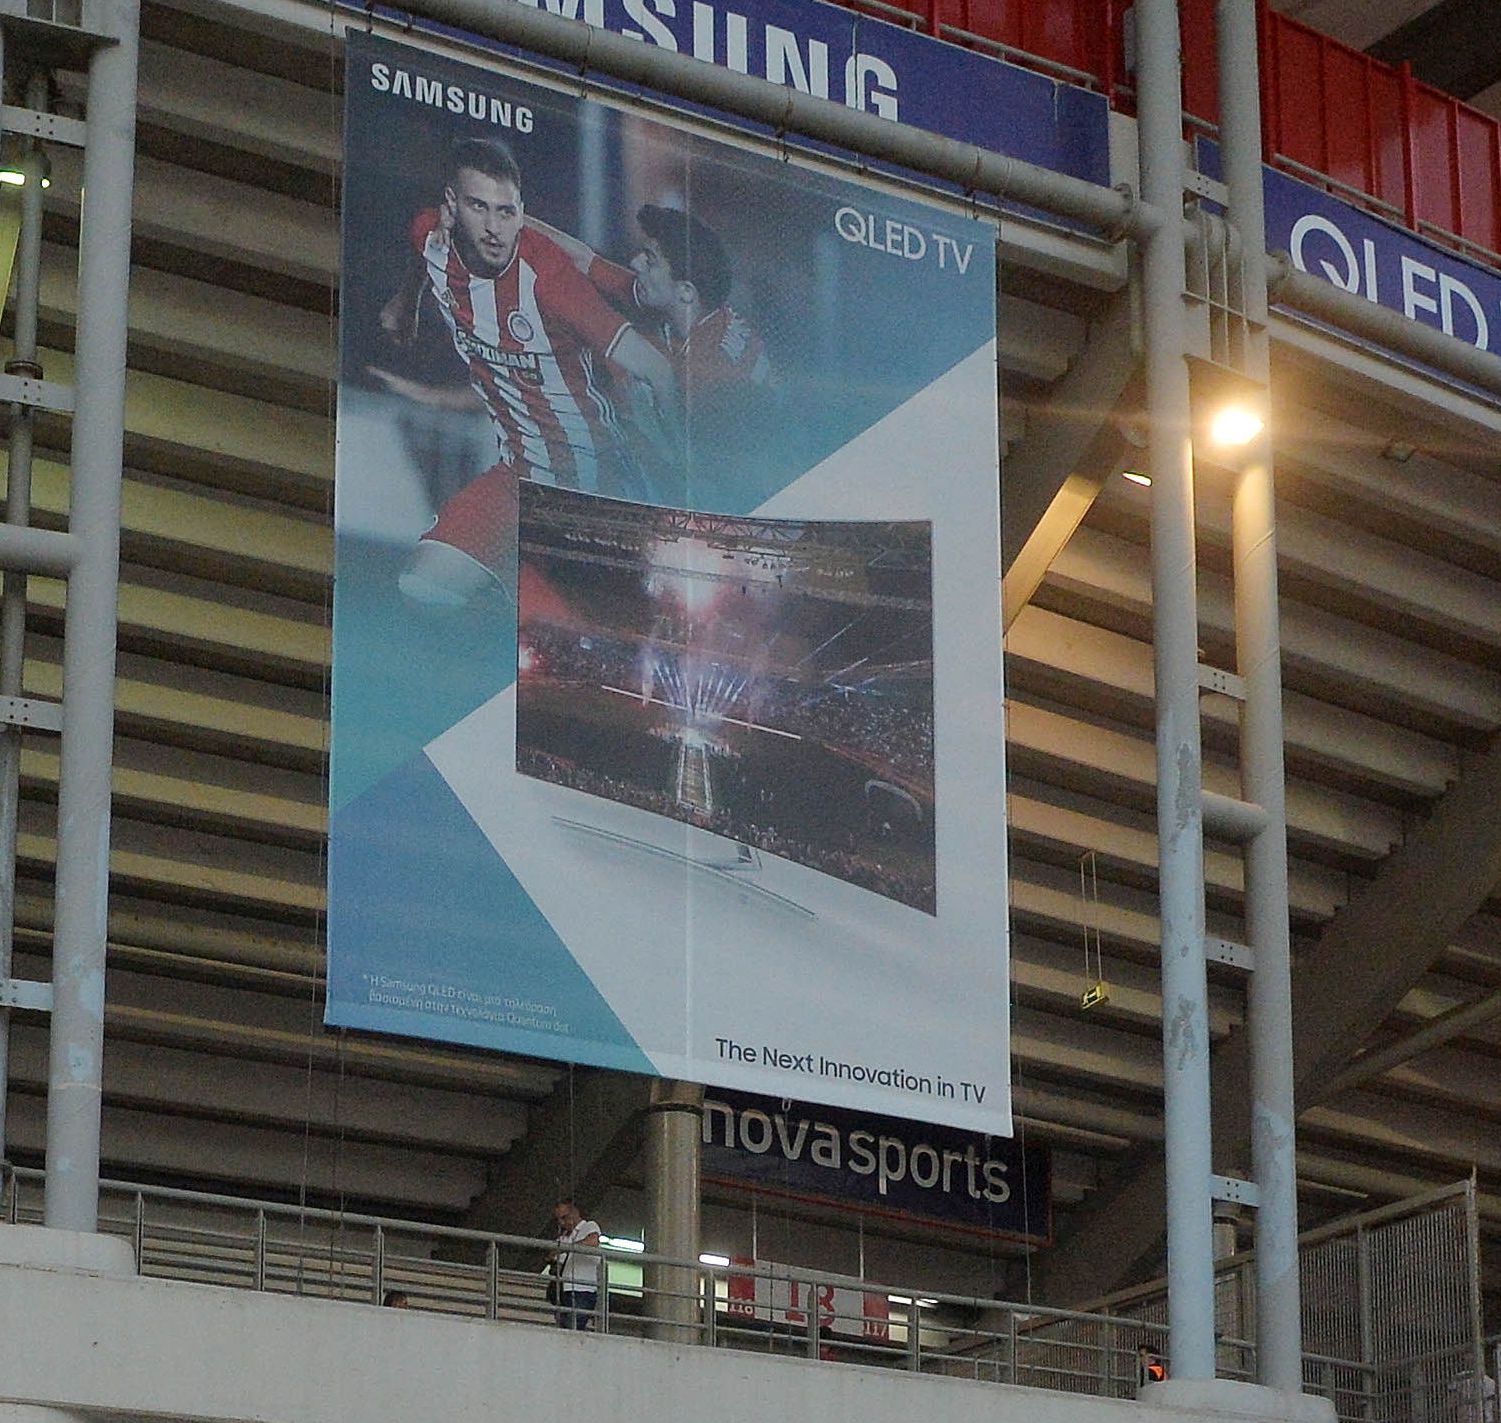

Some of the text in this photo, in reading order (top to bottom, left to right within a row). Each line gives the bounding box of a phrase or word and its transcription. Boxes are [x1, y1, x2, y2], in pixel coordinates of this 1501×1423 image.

[371, 62, 534, 134] SAMSUNG
[835, 206, 973, 275] QLED TV
[715, 1038, 986, 1104] The Next Innovation in TV
[701, 1100, 1011, 1203] novasports
